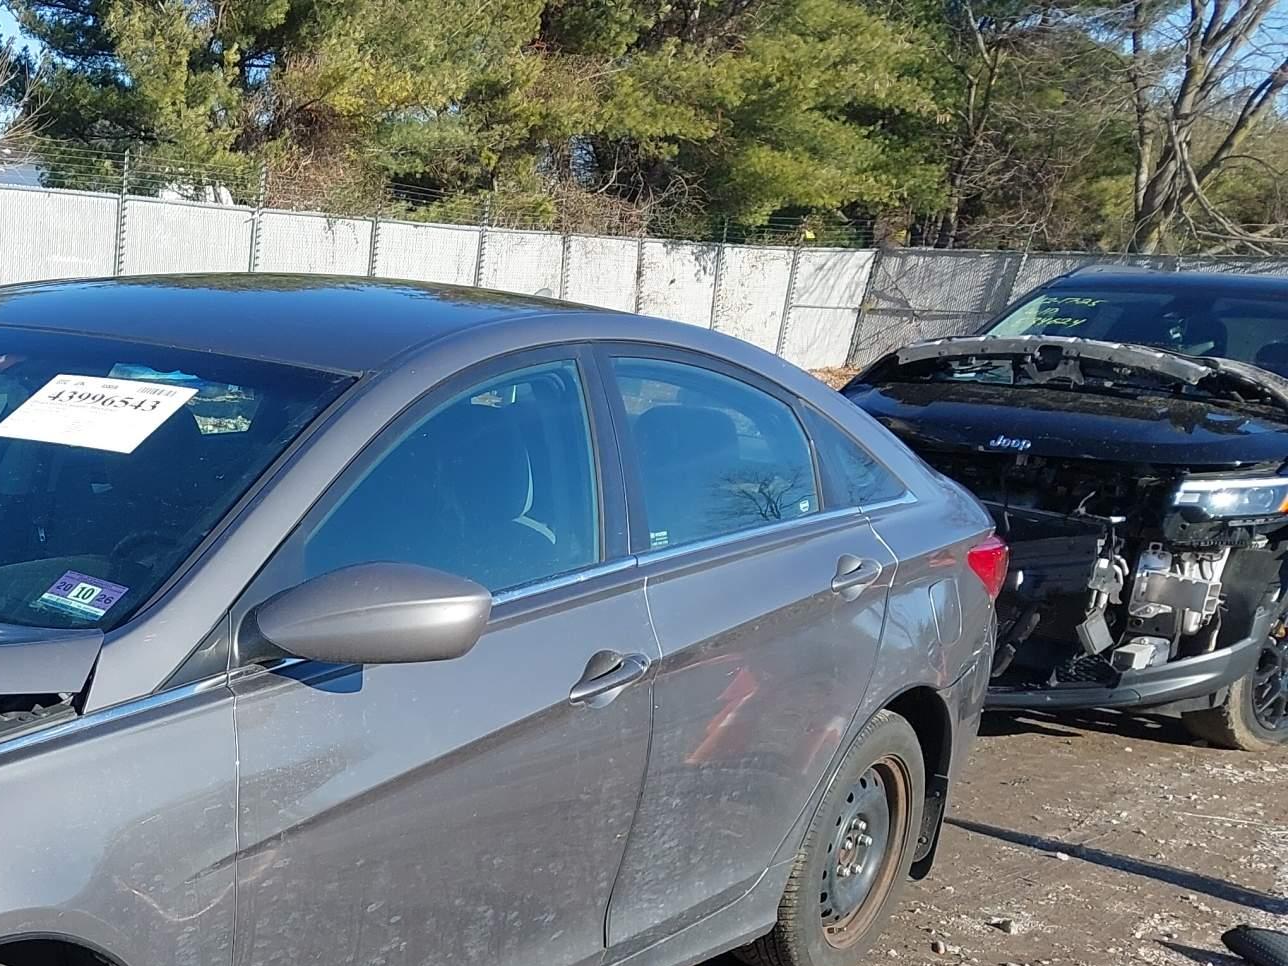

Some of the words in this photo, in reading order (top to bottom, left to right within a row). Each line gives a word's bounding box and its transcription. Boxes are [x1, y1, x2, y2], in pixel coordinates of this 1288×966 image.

[48, 389, 161, 412] 43996543
[56, 581, 73, 592] 20
[72, 586, 95, 600] 10
[96, 594, 114, 605] 26
